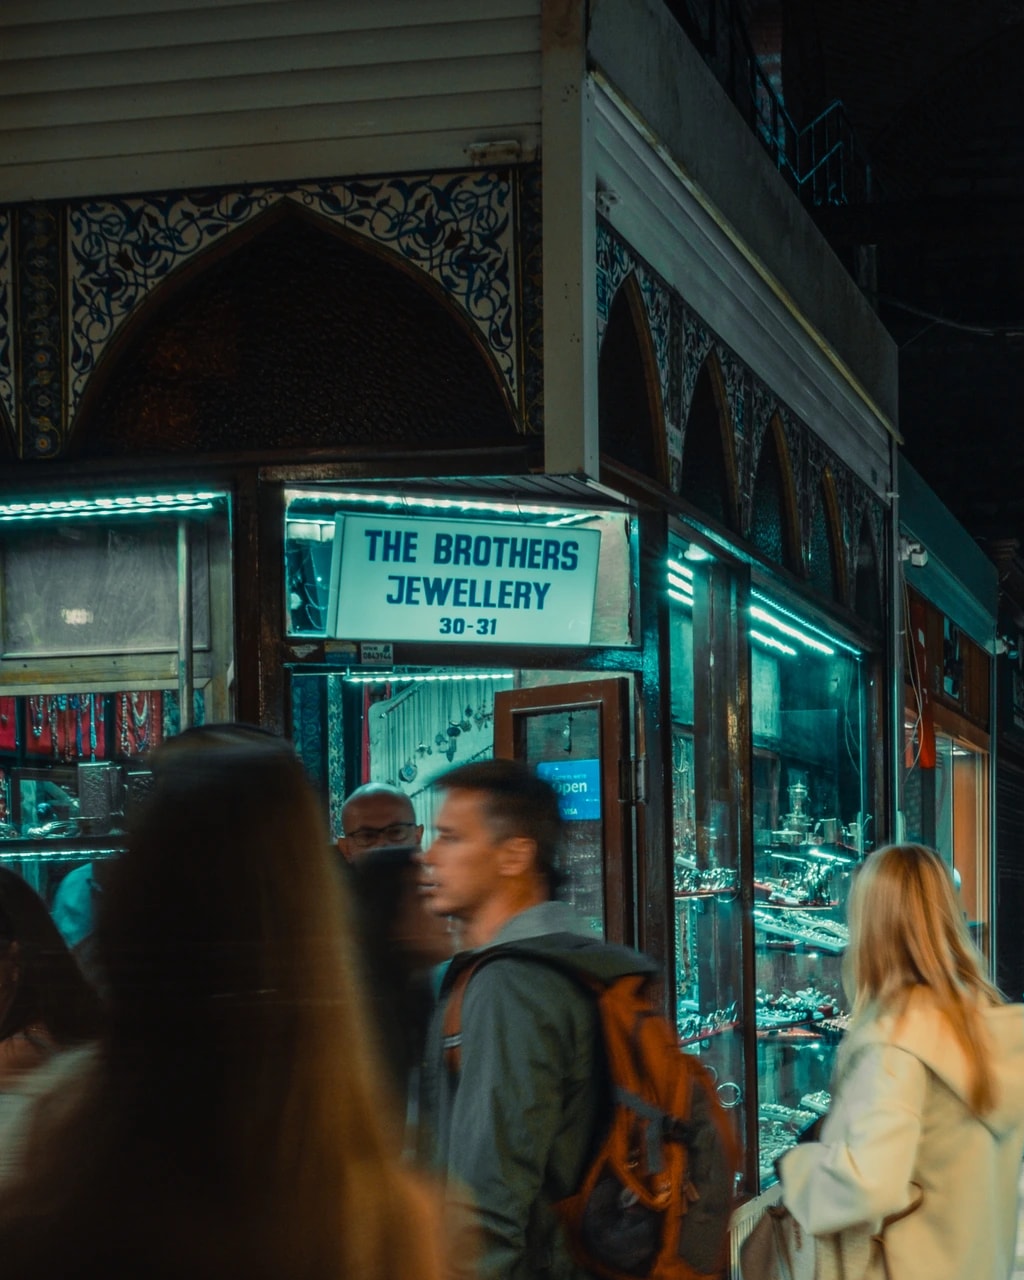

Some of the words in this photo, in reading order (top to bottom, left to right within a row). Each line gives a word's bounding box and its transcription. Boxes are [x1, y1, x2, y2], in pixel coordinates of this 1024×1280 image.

[364, 529, 419, 563] THE
[433, 533, 580, 571] BROTHERS
[386, 575, 552, 610] JEWELLERY
[439, 617, 498, 635] 30-31
[552, 781, 587, 796] Open
